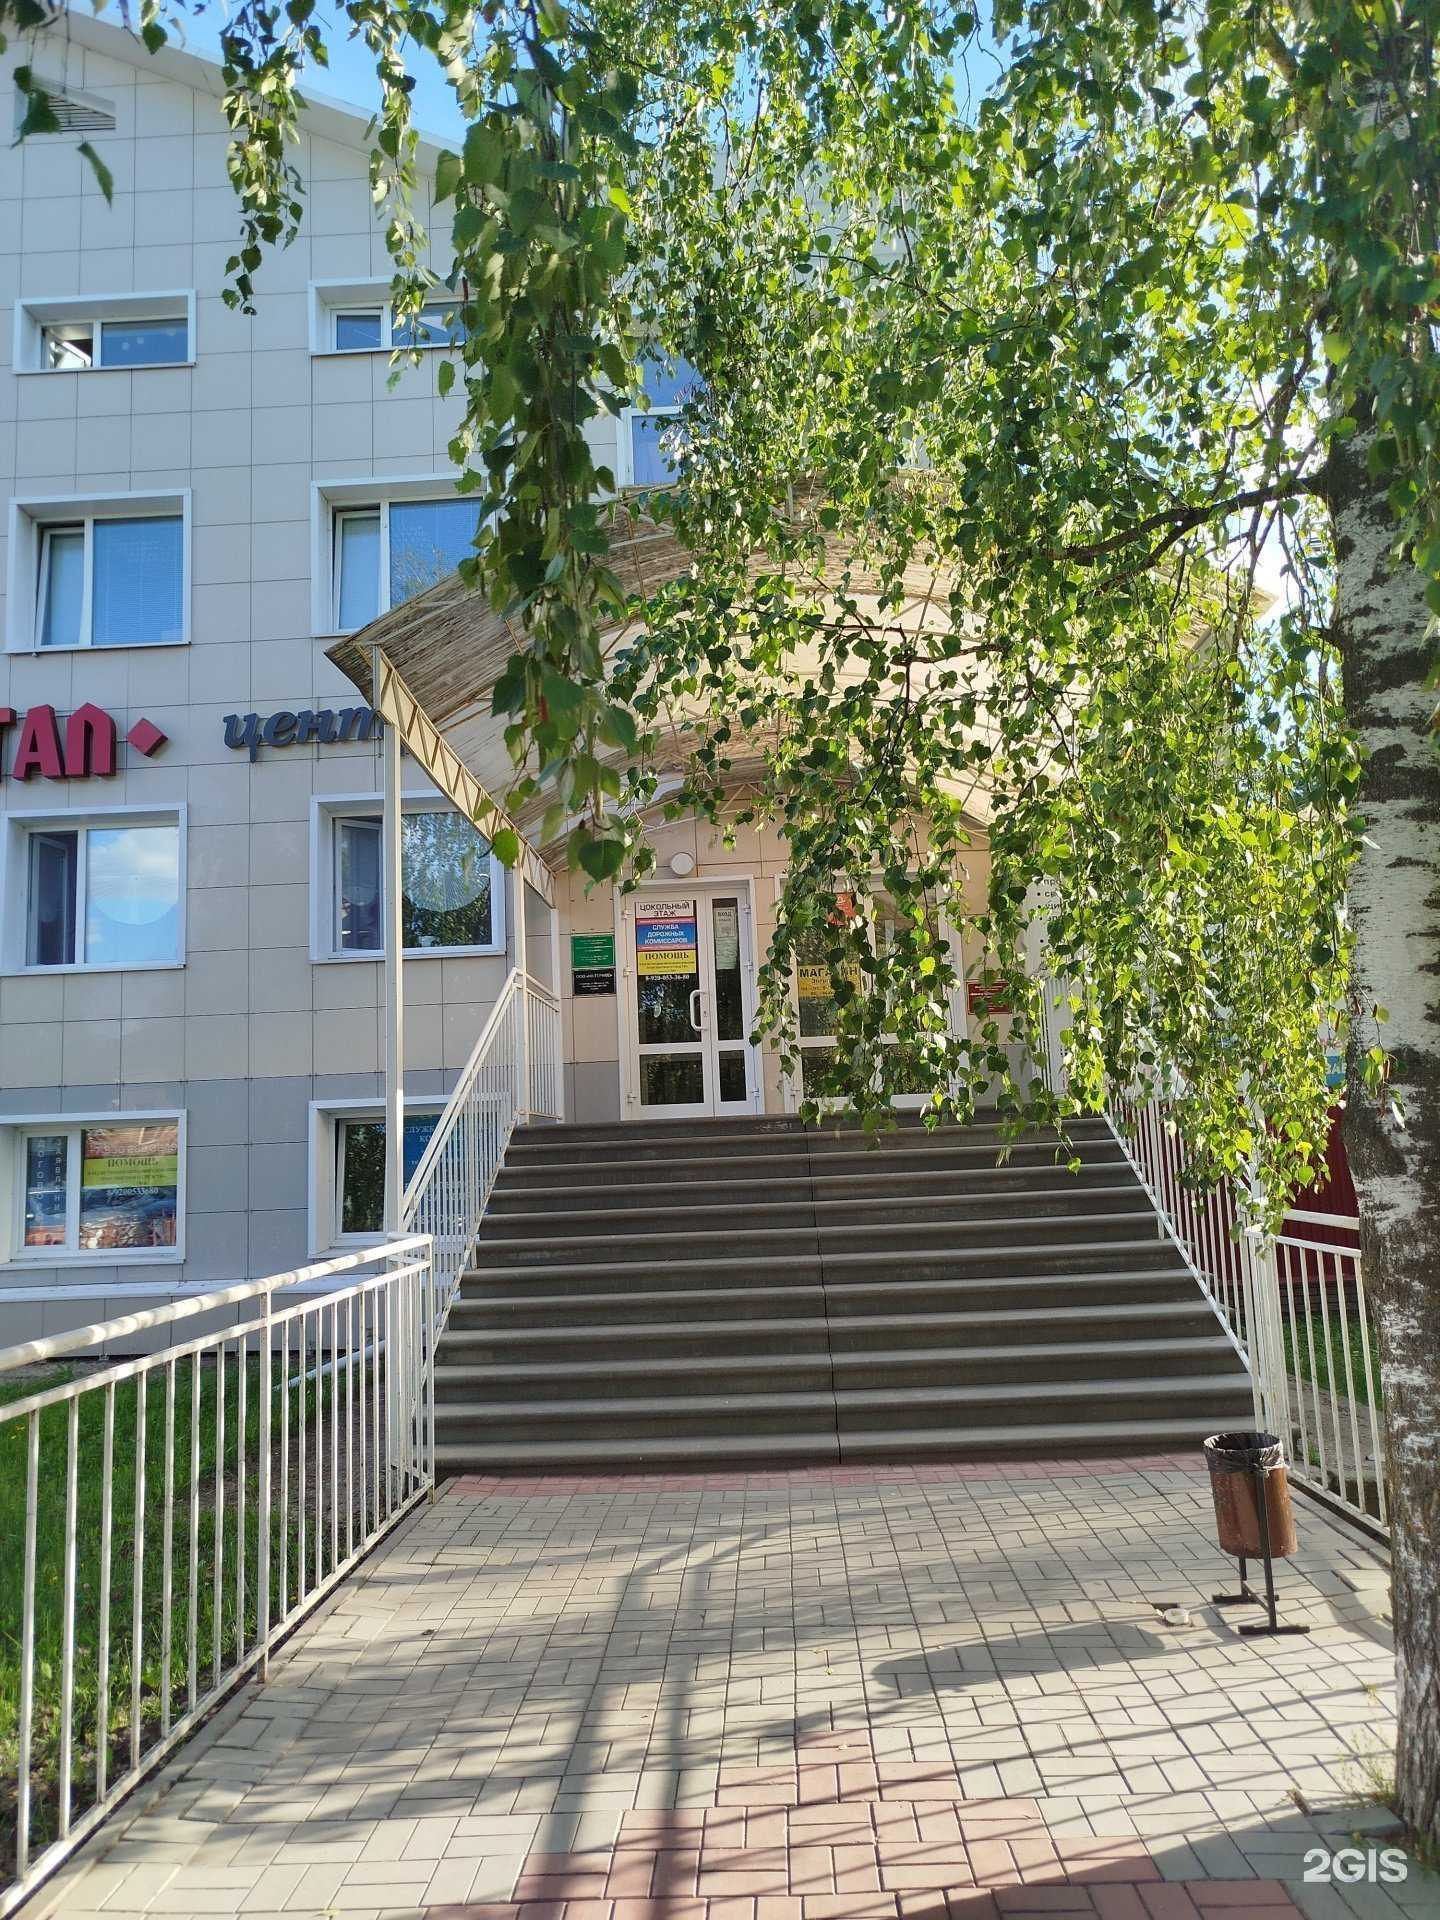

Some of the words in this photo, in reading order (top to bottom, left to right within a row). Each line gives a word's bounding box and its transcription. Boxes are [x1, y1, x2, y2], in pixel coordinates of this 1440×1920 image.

[639, 901, 690, 911] ЦОКОЛЬНЫЙ
[653, 909, 677, 917] ЭТАЖ
[645, 952, 689, 961] ПОМОЩЬ
[107, 1157, 159, 1169] ПОМОЩЬ
